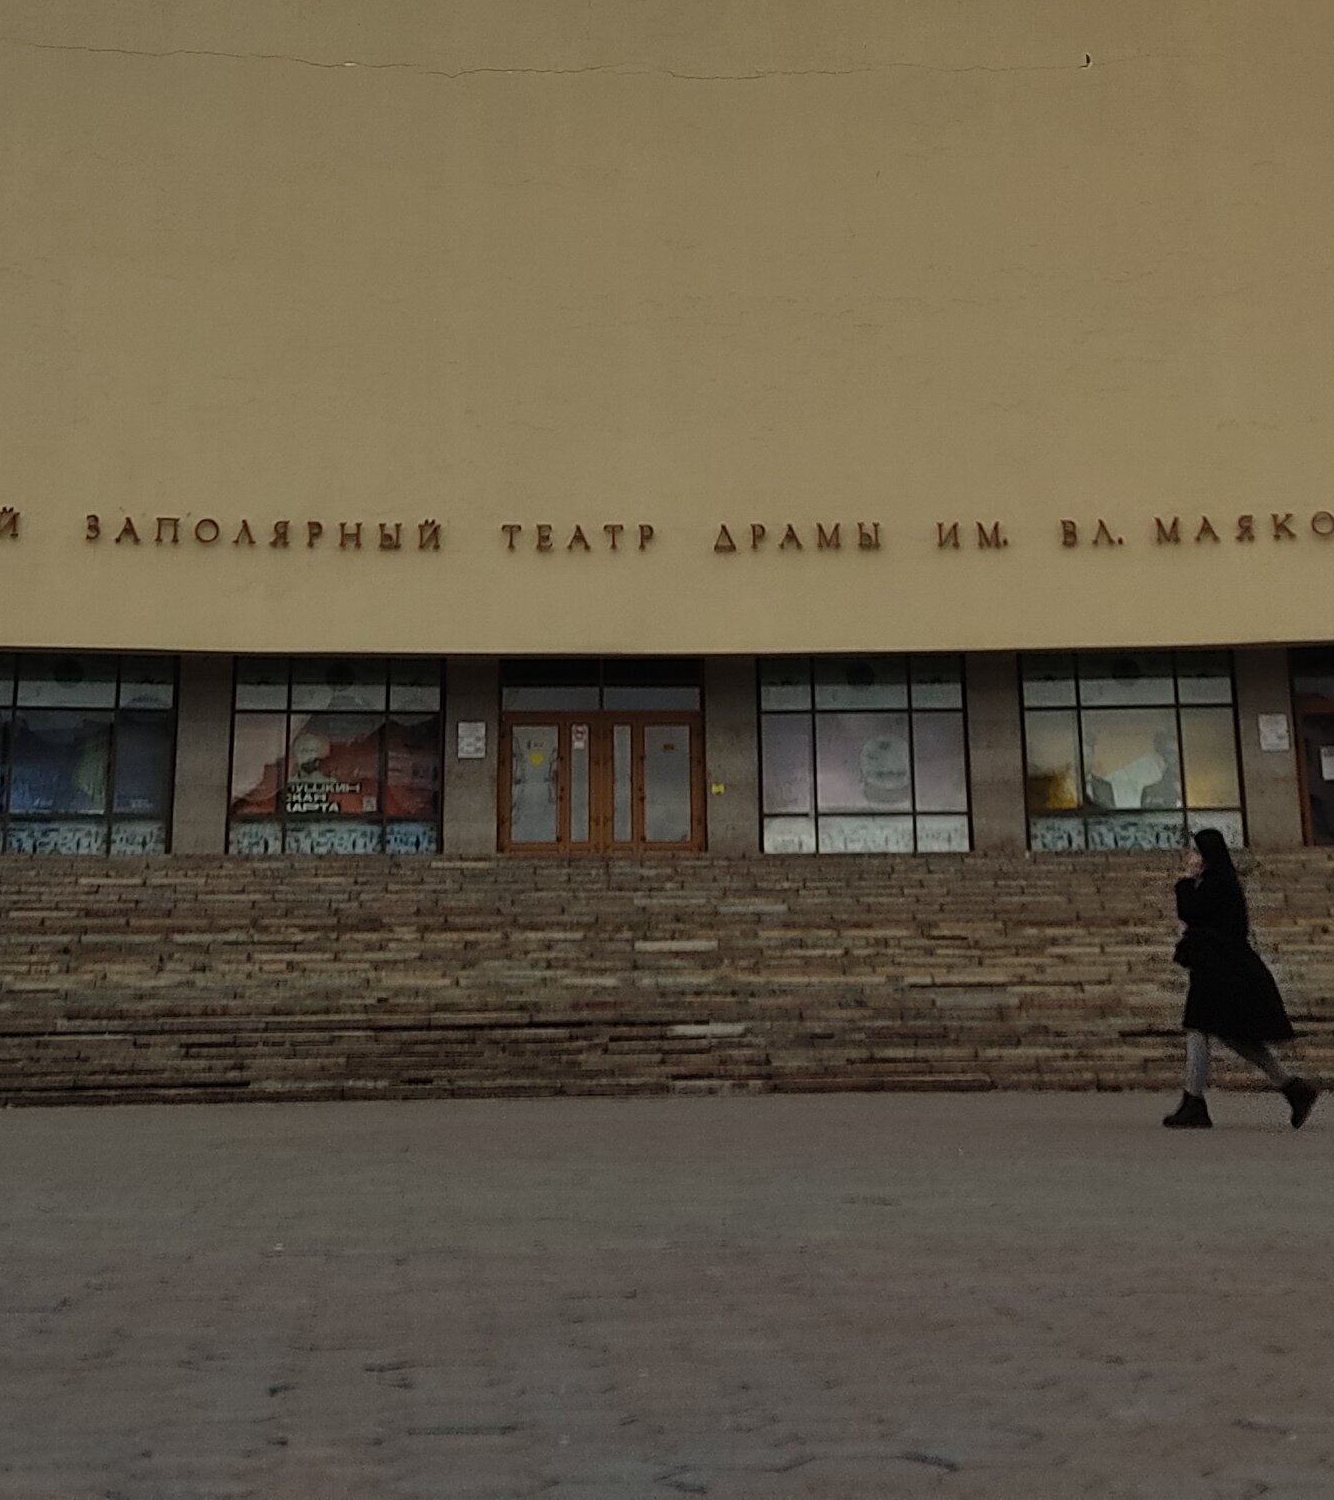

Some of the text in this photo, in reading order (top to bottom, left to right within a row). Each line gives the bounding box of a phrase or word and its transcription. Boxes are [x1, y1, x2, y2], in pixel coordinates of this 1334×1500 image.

[85, 513, 442, 550] ЗАПОЛЯРНЫЙ
[500, 523, 656, 552] ТЕАТР
[713, 521, 882, 553] ДРАМЫ
[936, 520, 1010, 550] ИМ.
[1059, 517, 1125, 549] ВЛ.
